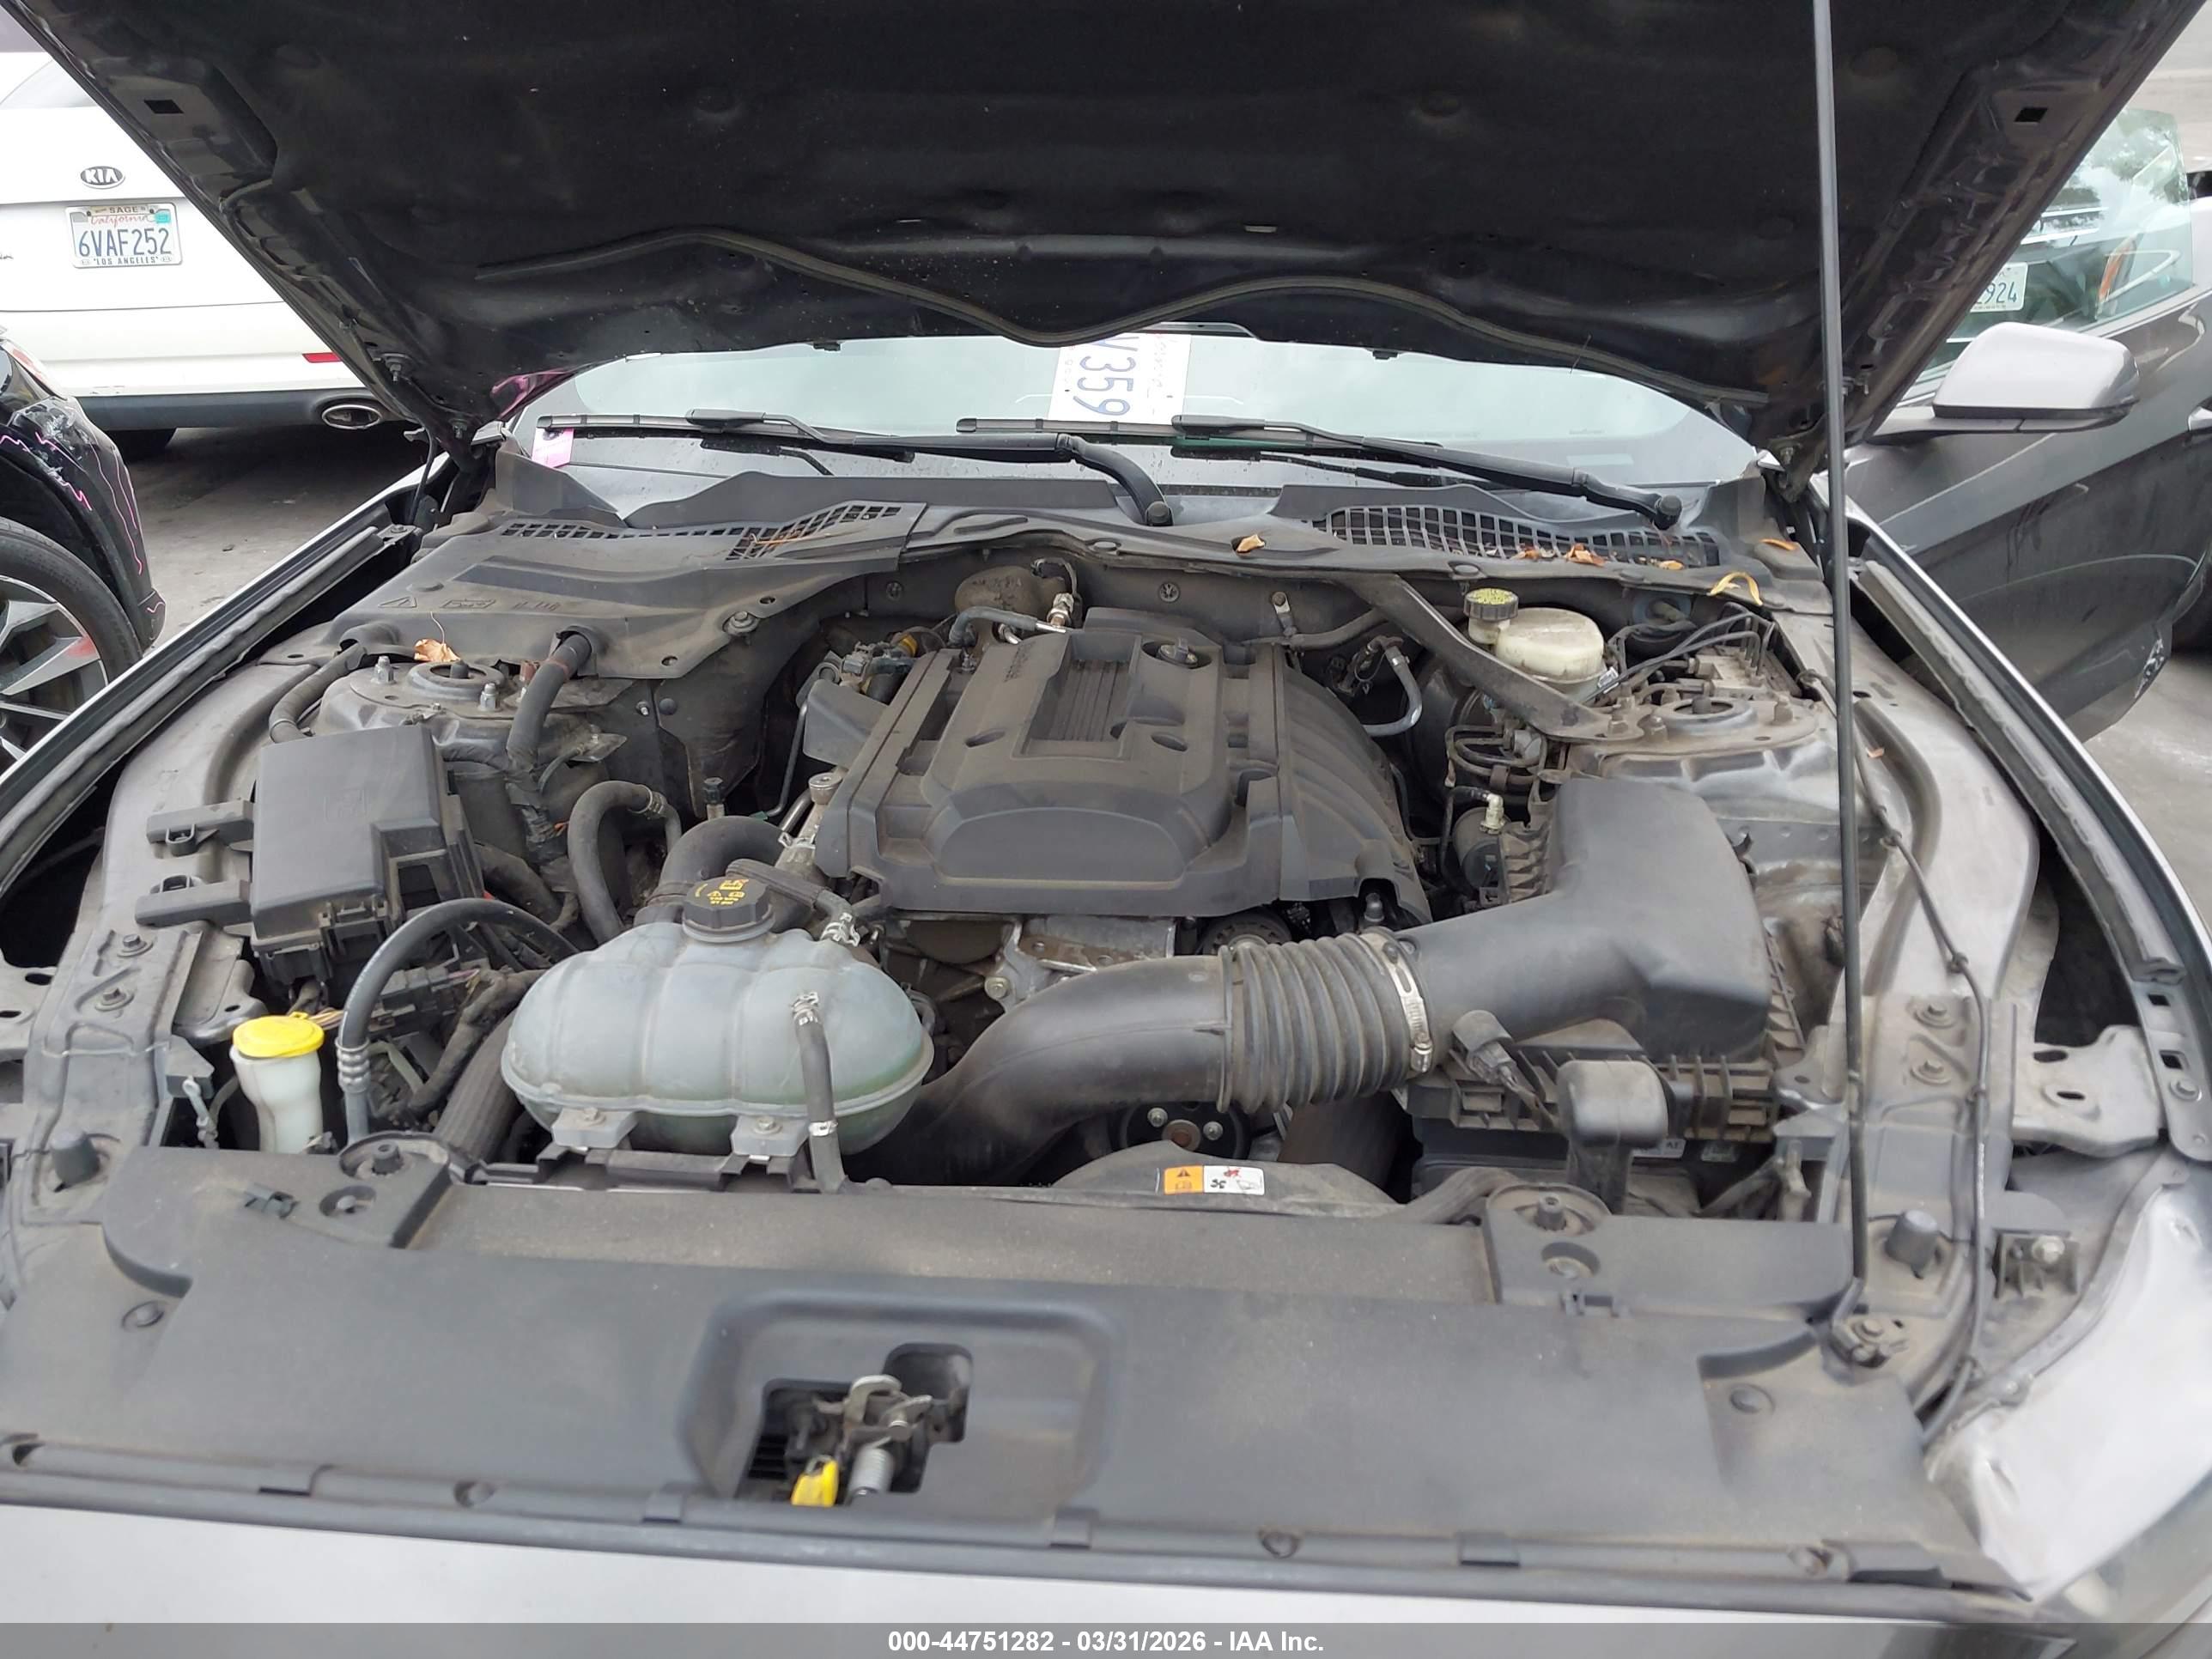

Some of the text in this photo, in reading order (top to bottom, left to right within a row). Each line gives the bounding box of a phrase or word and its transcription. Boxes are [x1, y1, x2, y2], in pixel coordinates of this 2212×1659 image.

[85, 168, 118, 184] KIA
[79, 228, 172, 257] 6VAF252
[1978, 281, 2017, 305] 924
